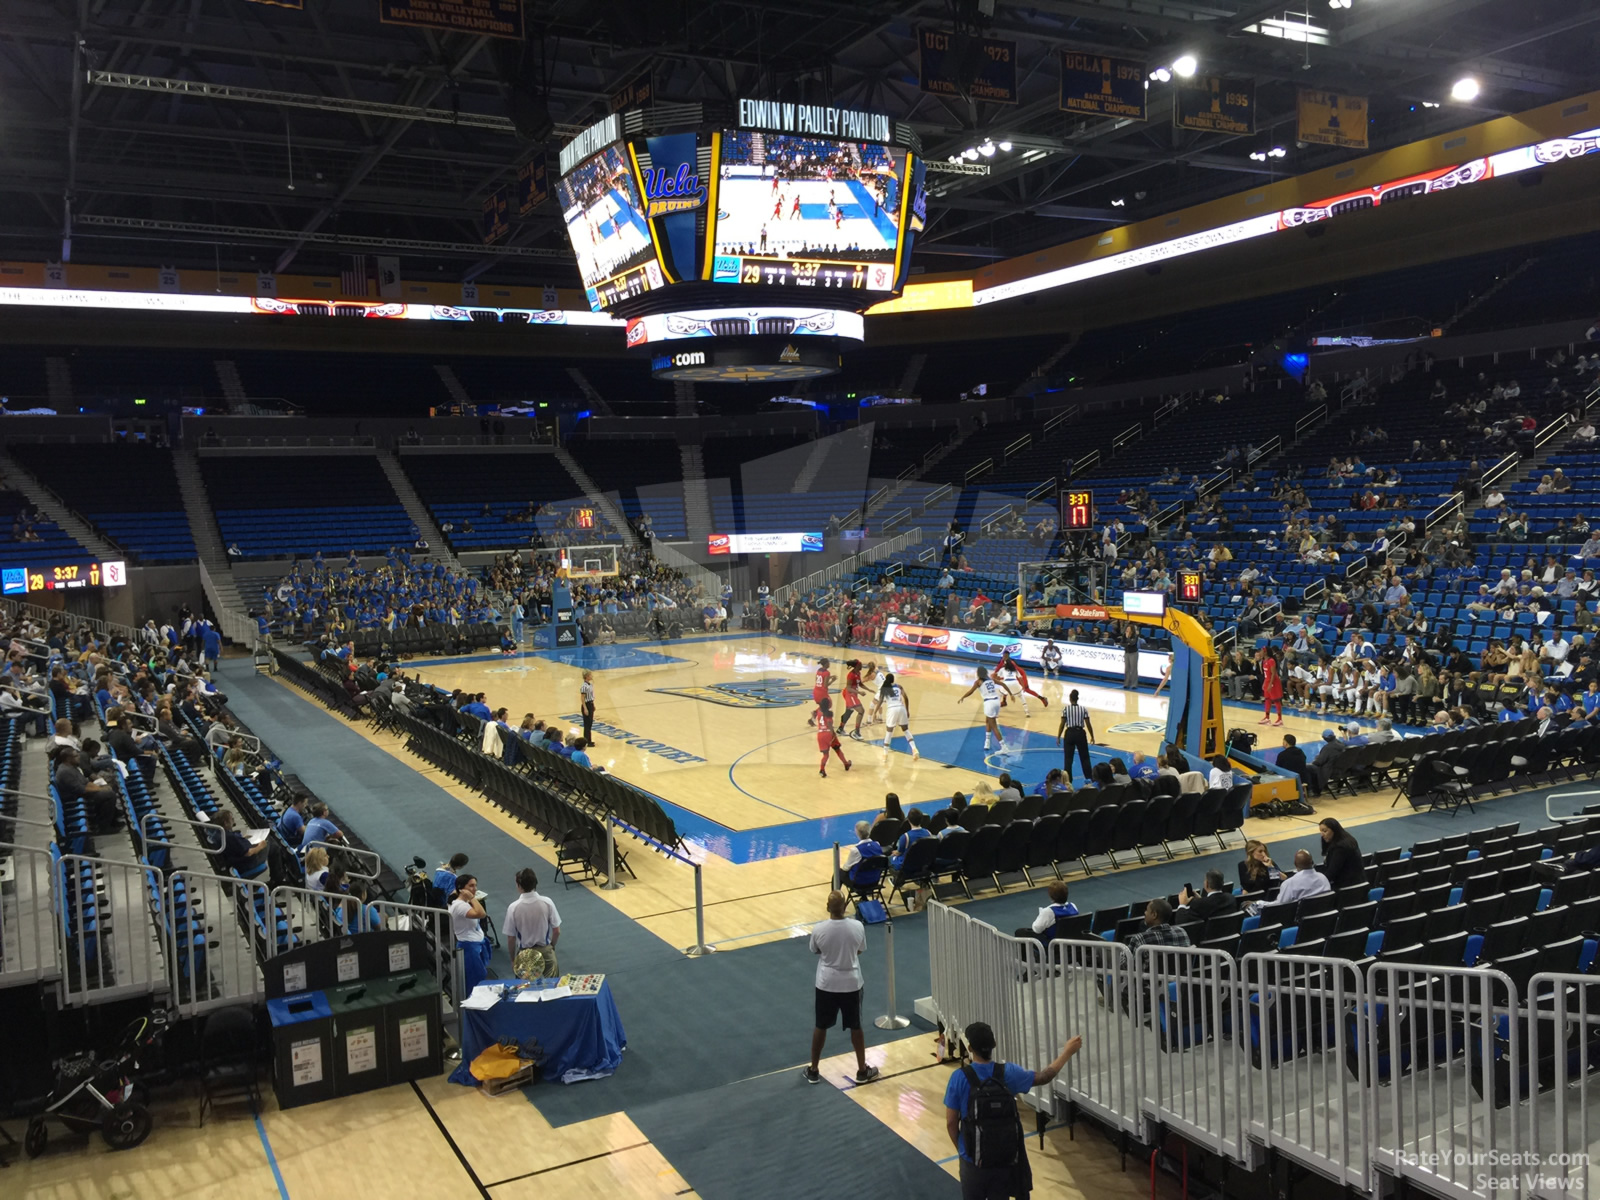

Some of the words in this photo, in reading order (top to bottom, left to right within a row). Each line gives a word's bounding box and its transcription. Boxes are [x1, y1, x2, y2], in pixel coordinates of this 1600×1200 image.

[439, 1, 496, 19] VOLLEYBALL
[390, 6, 451, 23] NATIONAL
[450, 14, 515, 33] CHAMPIONS
[1065, 53, 1101, 73] UCLA
[1117, 64, 1141, 81] 1975
[1084, 92, 1124, 104] BASKETBALL
[1226, 91, 1249, 107] 1995
[1067, 97, 1100, 111] NATIONAL
[1103, 102, 1141, 116] CHAMPIONS
[739, 98, 781, 130] EDWIN
[782, 102, 796, 131] W
[797, 104, 840, 136] PAULEY
[841, 108, 890, 142] PAVILION
[649, 199, 701, 217] BRUINS
[49, 271, 62, 280] 42
[743, 264, 761, 284] 29
[791, 262, 821, 278] 3:37
[163, 275, 176, 285] 25
[261, 280, 272, 289] 31
[766, 273, 775, 285] 3
[779, 274, 787, 285] 4
[852, 271, 865, 289] 17
[465, 290, 475, 299] 32
[1069, 493, 1089, 506] 3:37
[582, 516, 593, 528] 17
[1072, 506, 1087, 525] 17
[54, 565, 79, 580] 3:37
[90, 570, 100, 586] 17
[30, 573, 45, 590] 29
[1186, 585, 1197, 597] 17
[1076, 649, 1117, 661] CROSSTOWN
[816, 674, 824, 685] 20
[985, 681, 996, 690] 25
[819, 715, 826, 726] 4
[625, 738, 709, 764] COURT
